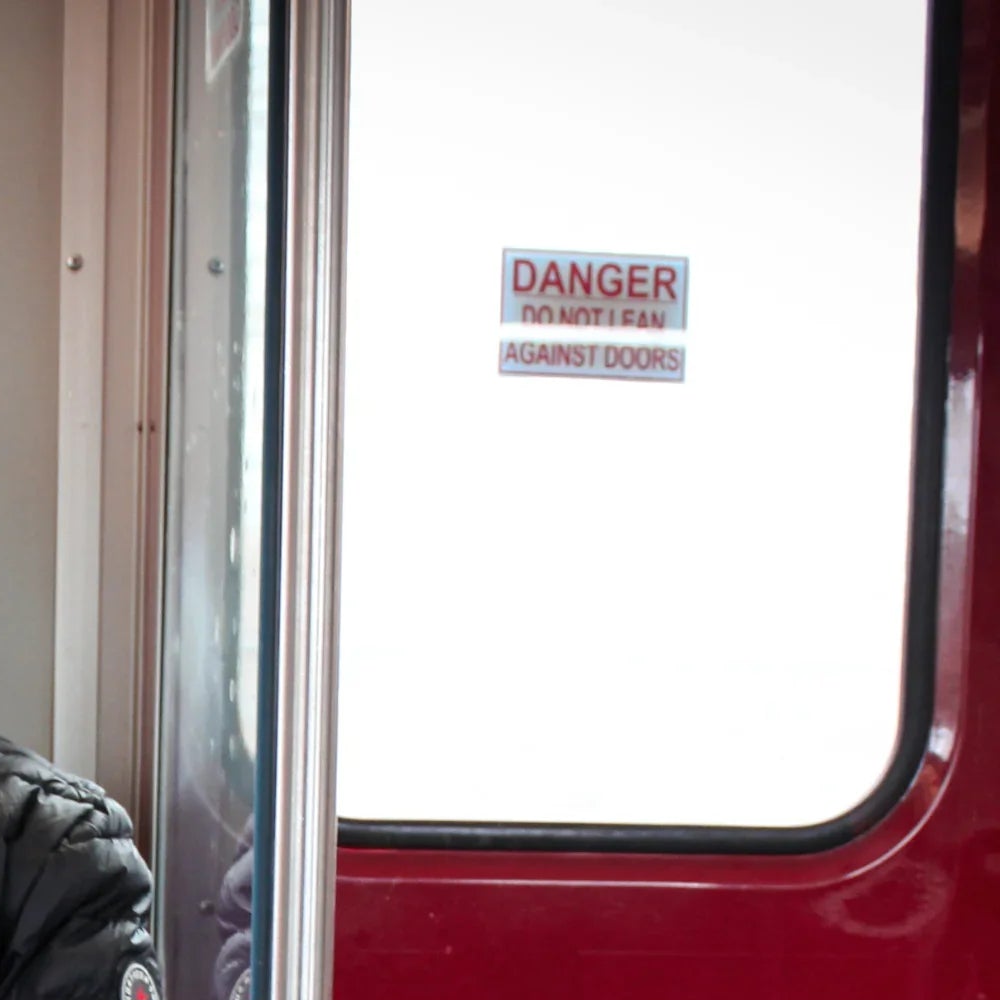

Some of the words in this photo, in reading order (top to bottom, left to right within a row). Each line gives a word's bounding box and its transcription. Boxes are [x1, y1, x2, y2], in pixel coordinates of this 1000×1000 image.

[512, 258, 677, 300] DANGER
[522, 304, 554, 325] DO
[559, 305, 604, 327] NOT
[505, 341, 599, 368] AGAINST
[604, 345, 681, 371] DOORS
